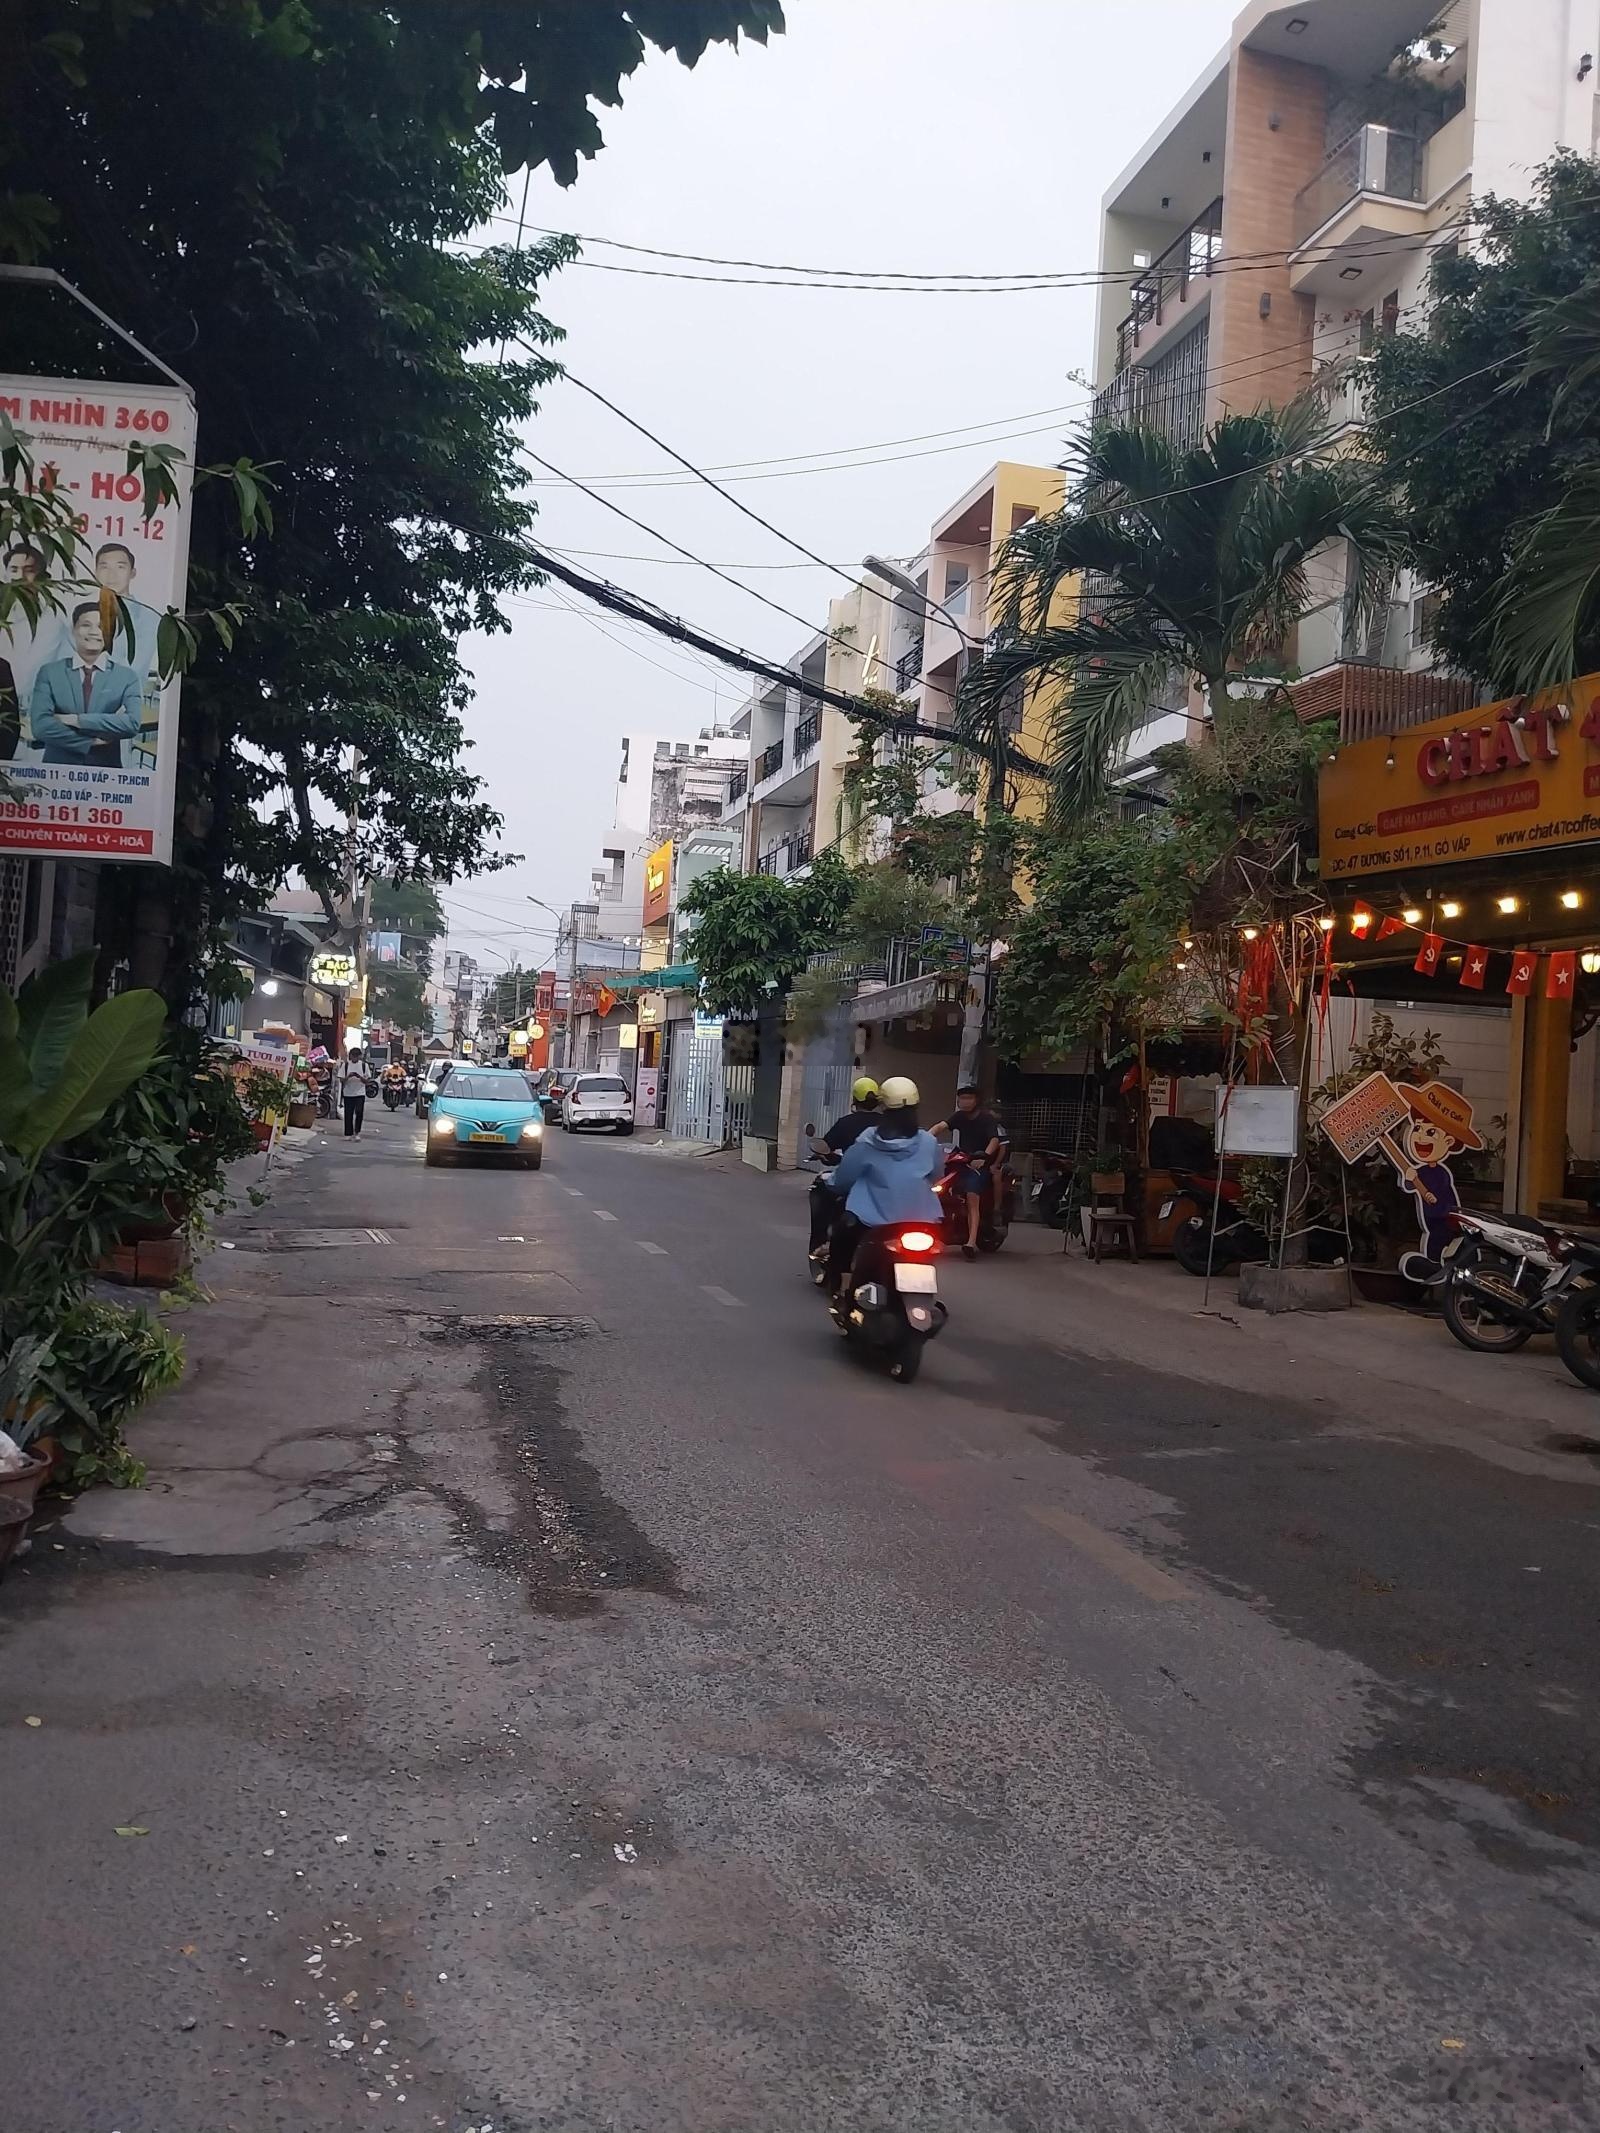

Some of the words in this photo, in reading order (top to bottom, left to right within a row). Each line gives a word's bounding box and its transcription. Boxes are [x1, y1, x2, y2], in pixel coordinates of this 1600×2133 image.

[30, 397, 105, 427] NHÌN
[115, 407, 169, 433] 360
[1417, 694, 1570, 786] CHẤT
[50, 770, 59, 780] 11
[118, 774, 150, 787] TP.HCM
[101, 792, 133, 804] TP.HCM
[48, 804, 79, 822] 161
[88, 807, 123, 825] 360
[5, 828, 53, 840] CHUYÊN
[55, 830, 87, 844] TOÁN
[1347, 854, 1358, 870] 47
[1349, 1110, 1400, 1152] 090.190.1080
